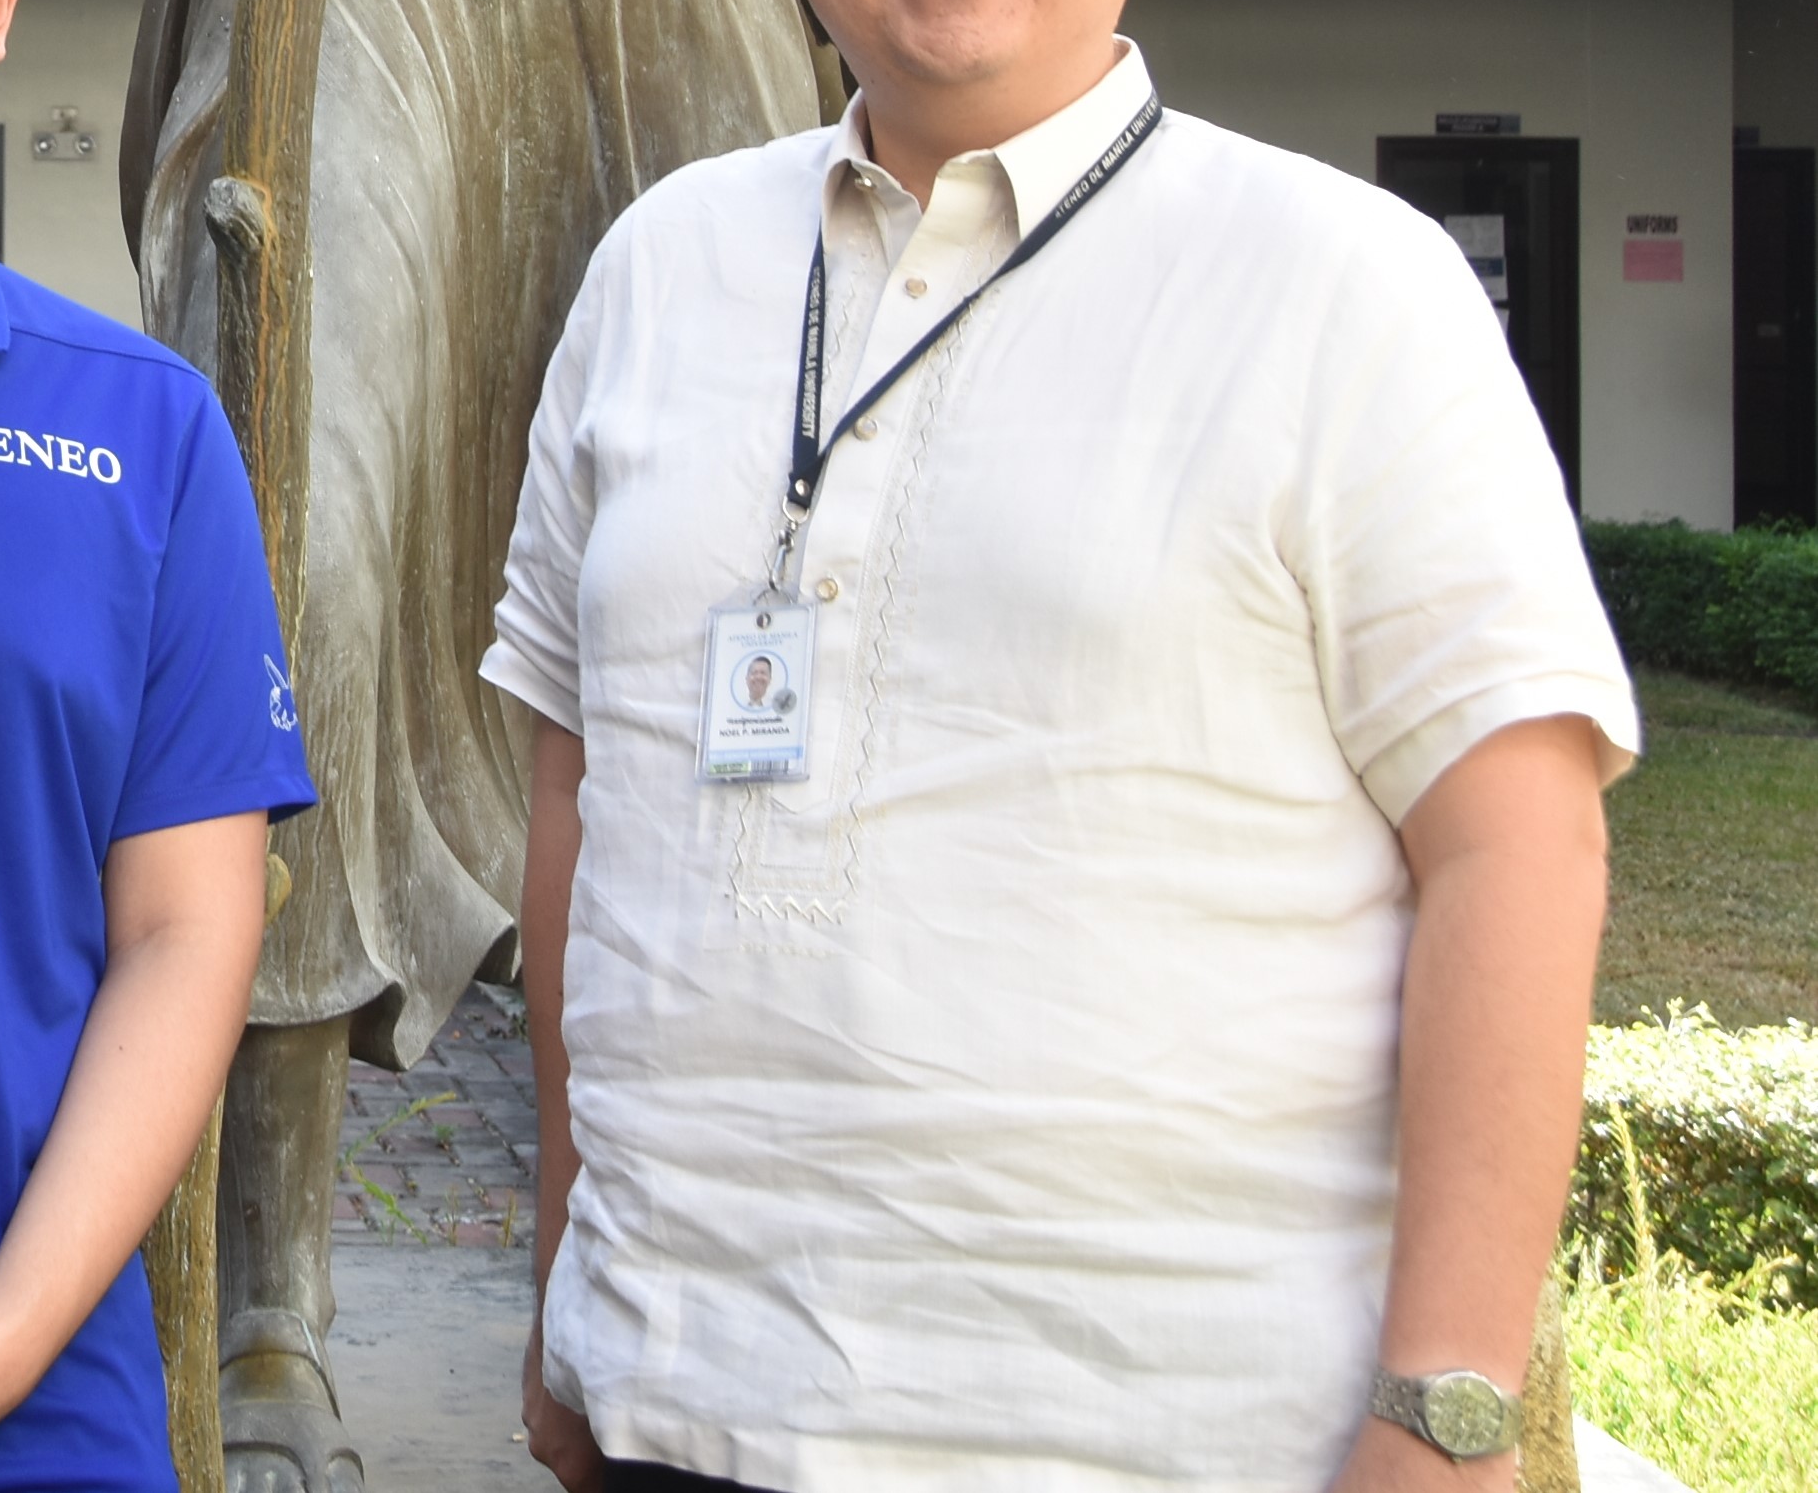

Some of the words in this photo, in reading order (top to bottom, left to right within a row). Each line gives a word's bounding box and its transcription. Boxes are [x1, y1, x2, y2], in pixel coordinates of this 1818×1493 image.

[1101, 129, 1136, 171] MANILA
[719, 729, 740, 737] NOEL
[751, 726, 790, 735] MIRANDA
